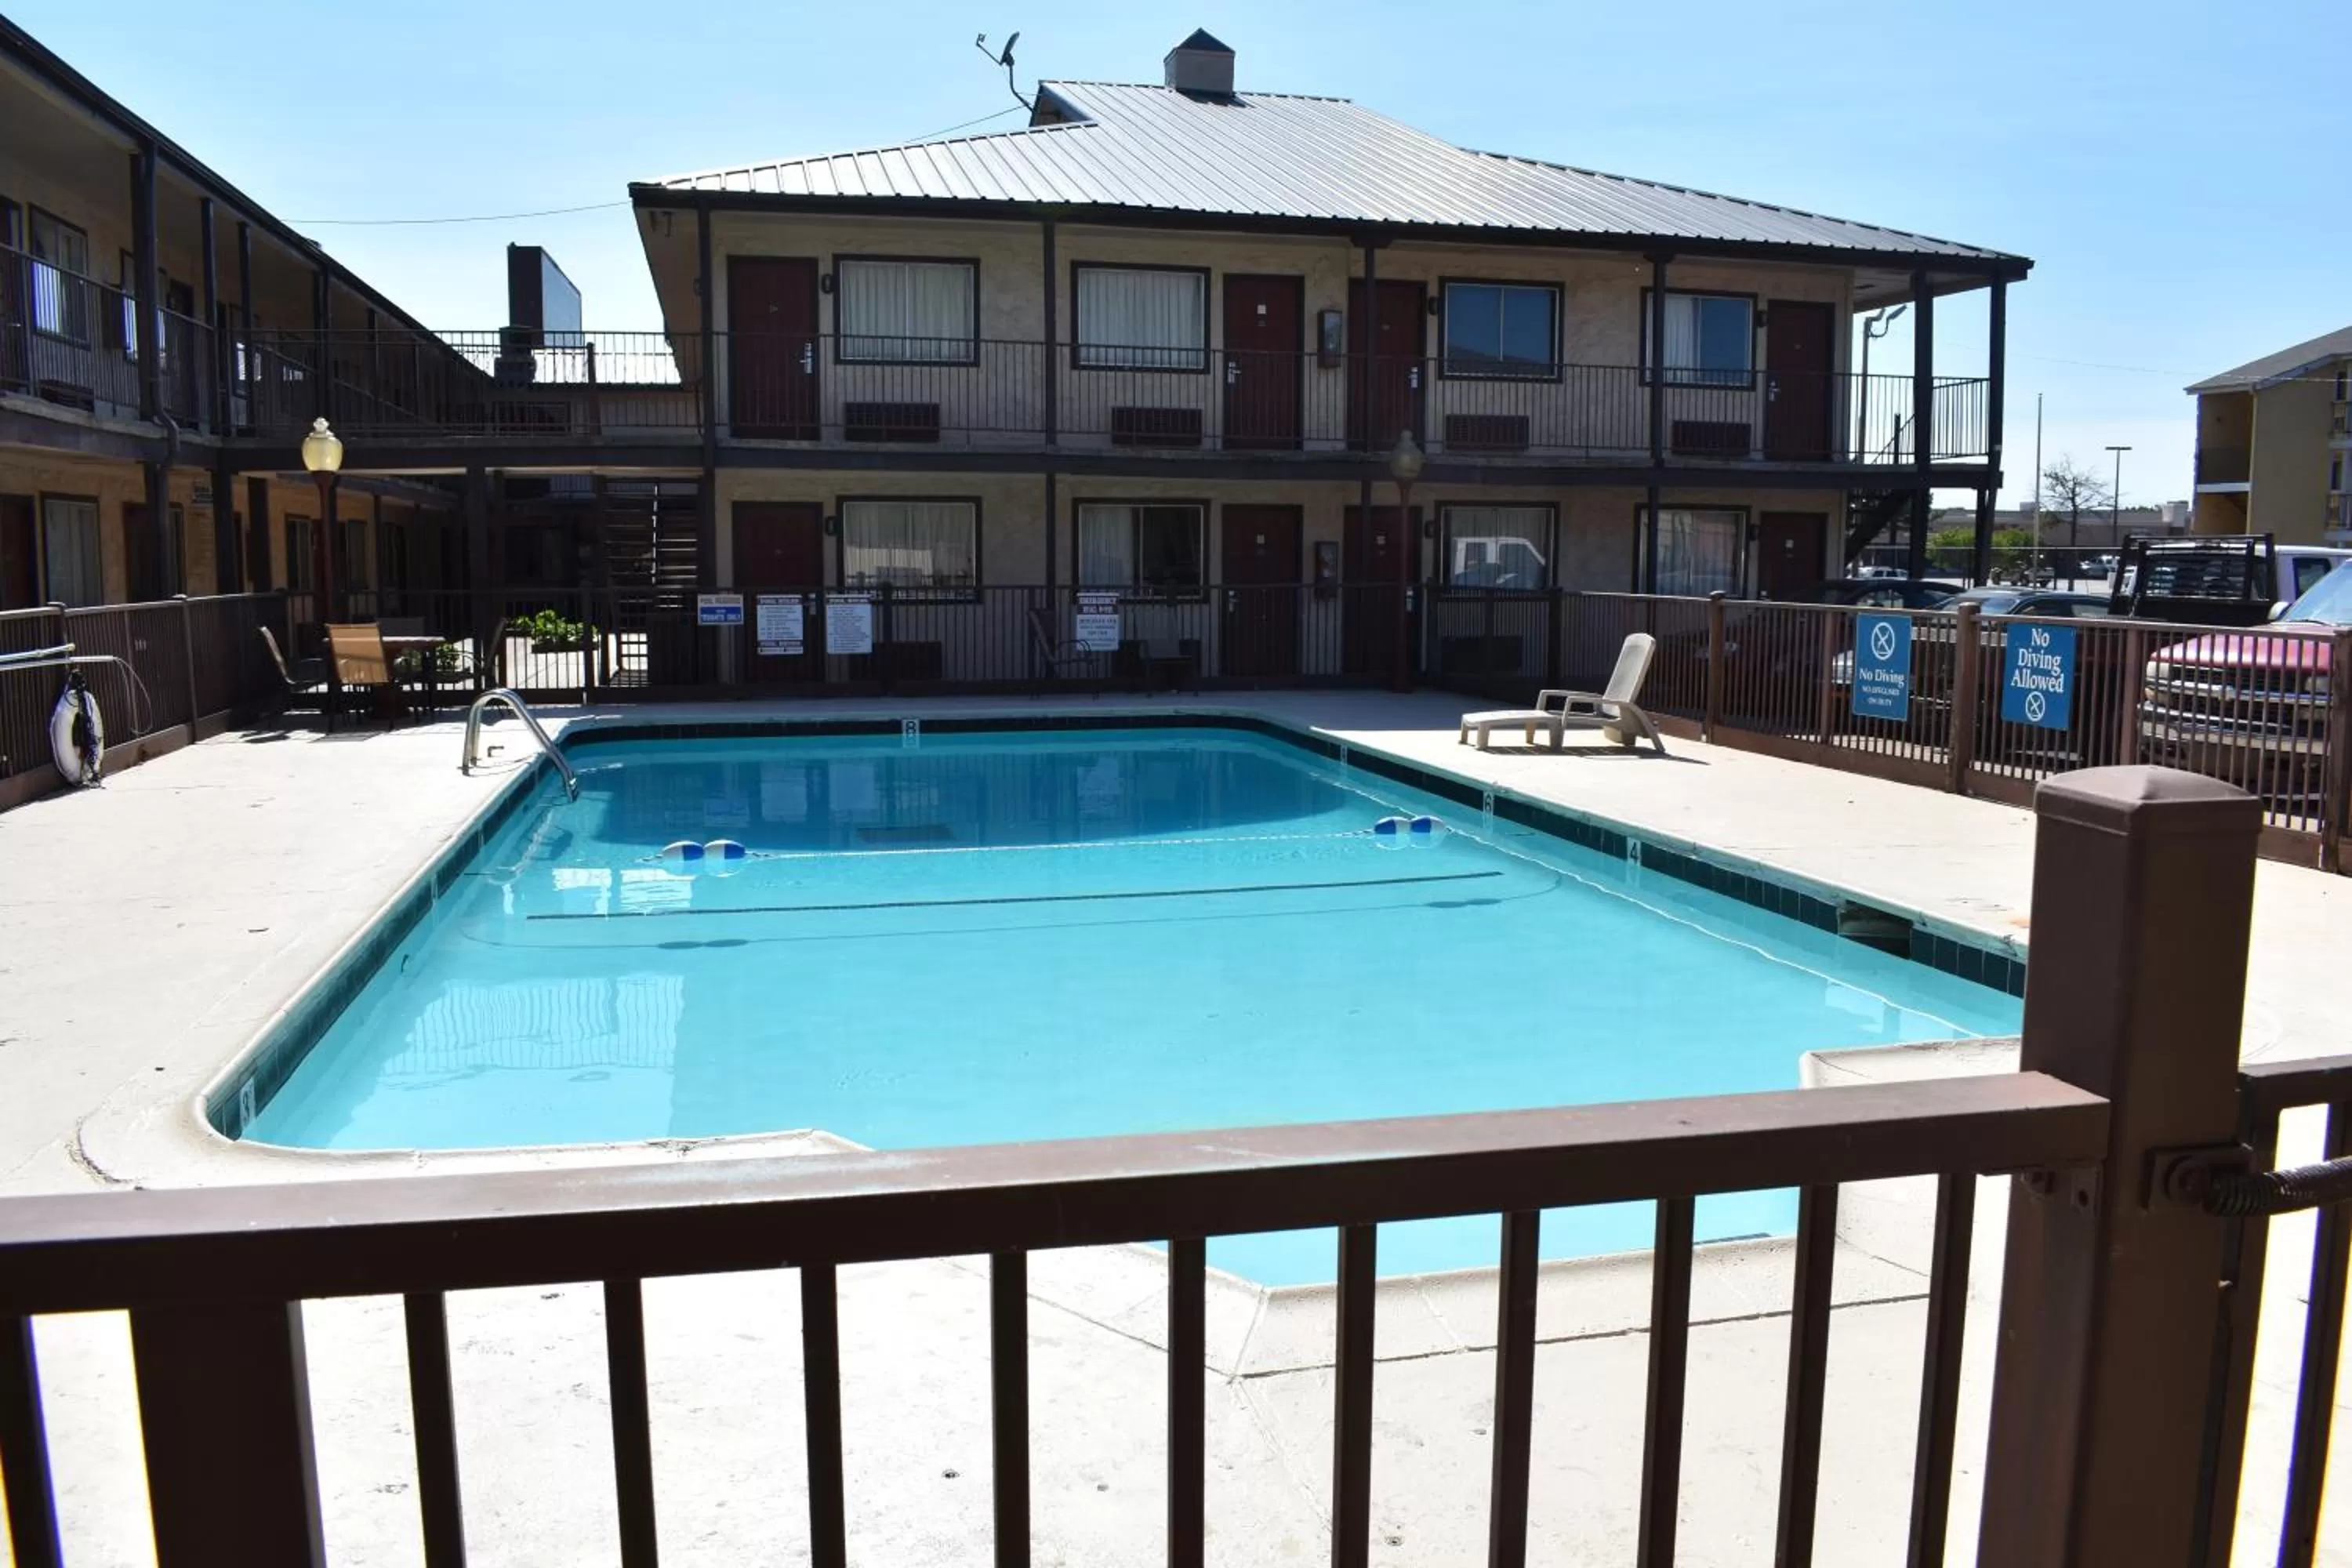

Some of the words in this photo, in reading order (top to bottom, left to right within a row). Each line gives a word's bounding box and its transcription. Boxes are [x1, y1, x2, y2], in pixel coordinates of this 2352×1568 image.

[2031, 628, 2050, 648] No
[2017, 648, 2062, 676] Diving
[1859, 667, 1873, 681] No
[1875, 669, 1905, 689] Diving
[2010, 669, 2064, 693] Allowed
[1630, 841, 1639, 863] 4
